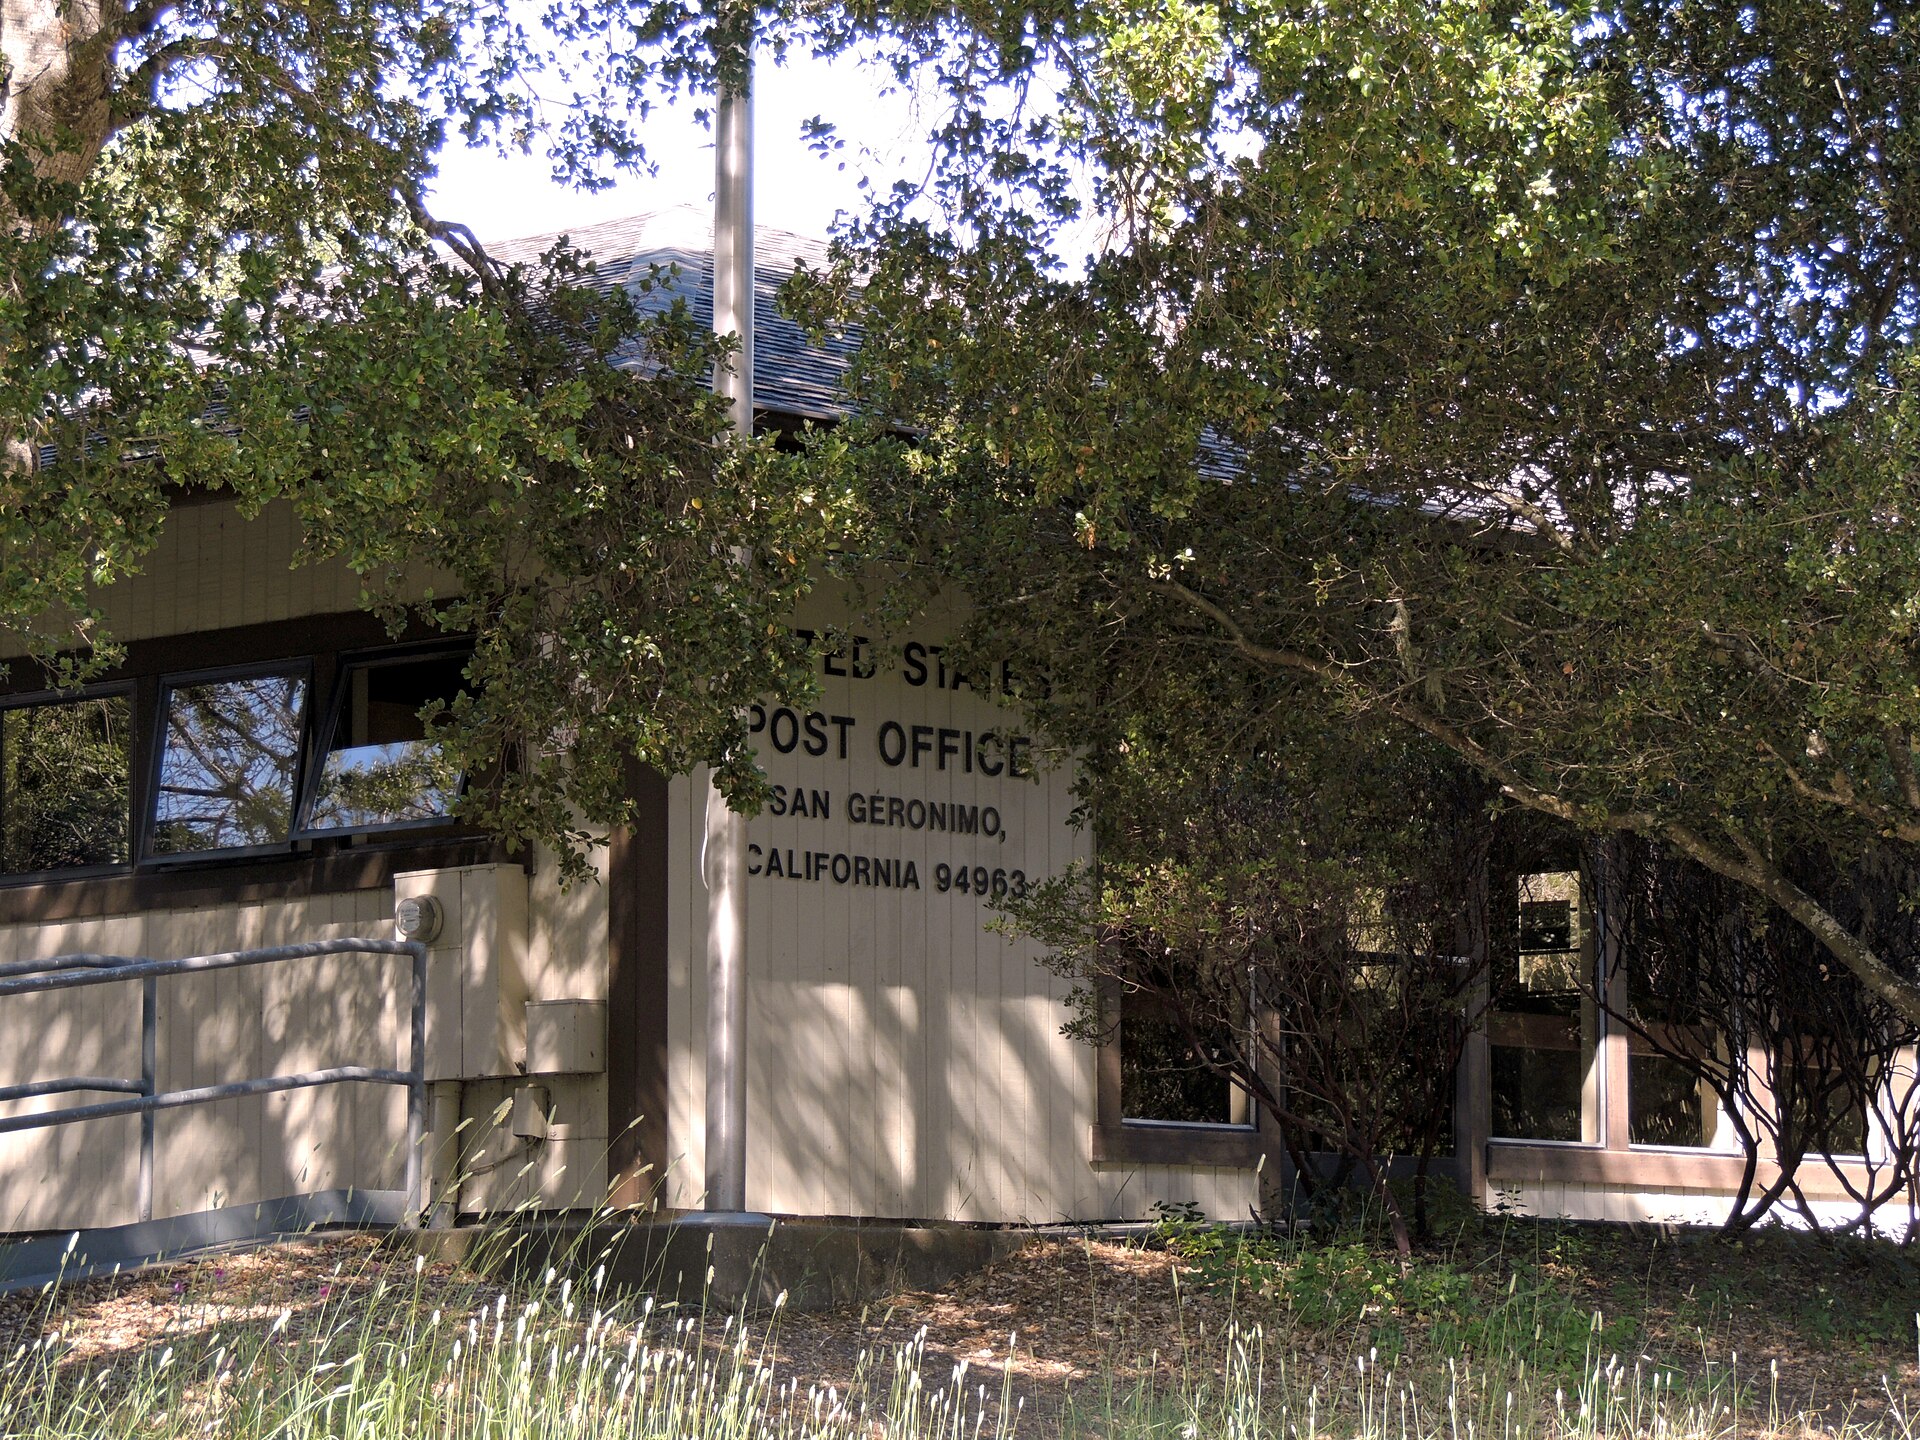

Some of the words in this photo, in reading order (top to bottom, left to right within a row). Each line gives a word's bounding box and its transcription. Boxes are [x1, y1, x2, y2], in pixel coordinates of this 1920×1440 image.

[878, 720, 1030, 778] OFFICE
[770, 784, 830, 819] SAN
[748, 843, 920, 891] CALIFORNIA
[936, 862, 1027, 899] 94963
